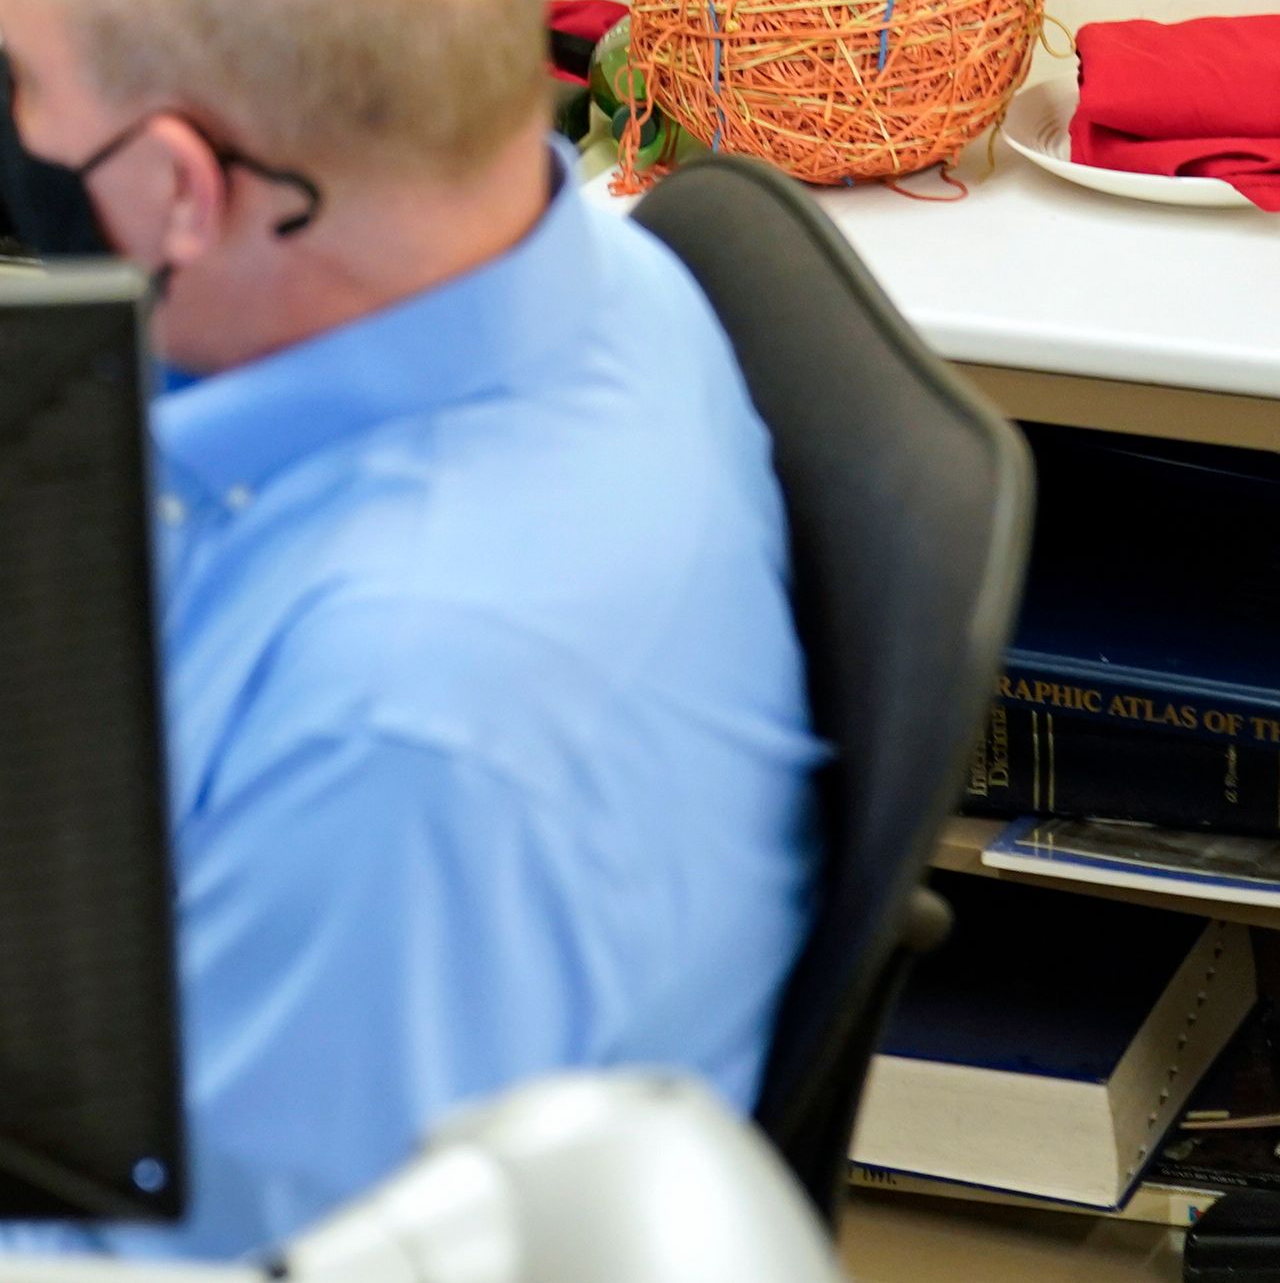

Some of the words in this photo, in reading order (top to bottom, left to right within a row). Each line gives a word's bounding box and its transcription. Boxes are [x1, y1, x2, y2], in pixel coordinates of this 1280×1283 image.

[996, 675, 1102, 714] RAPHIC
[1107, 694, 1198, 730] ATLAS
[1203, 709, 1244, 736] OF
